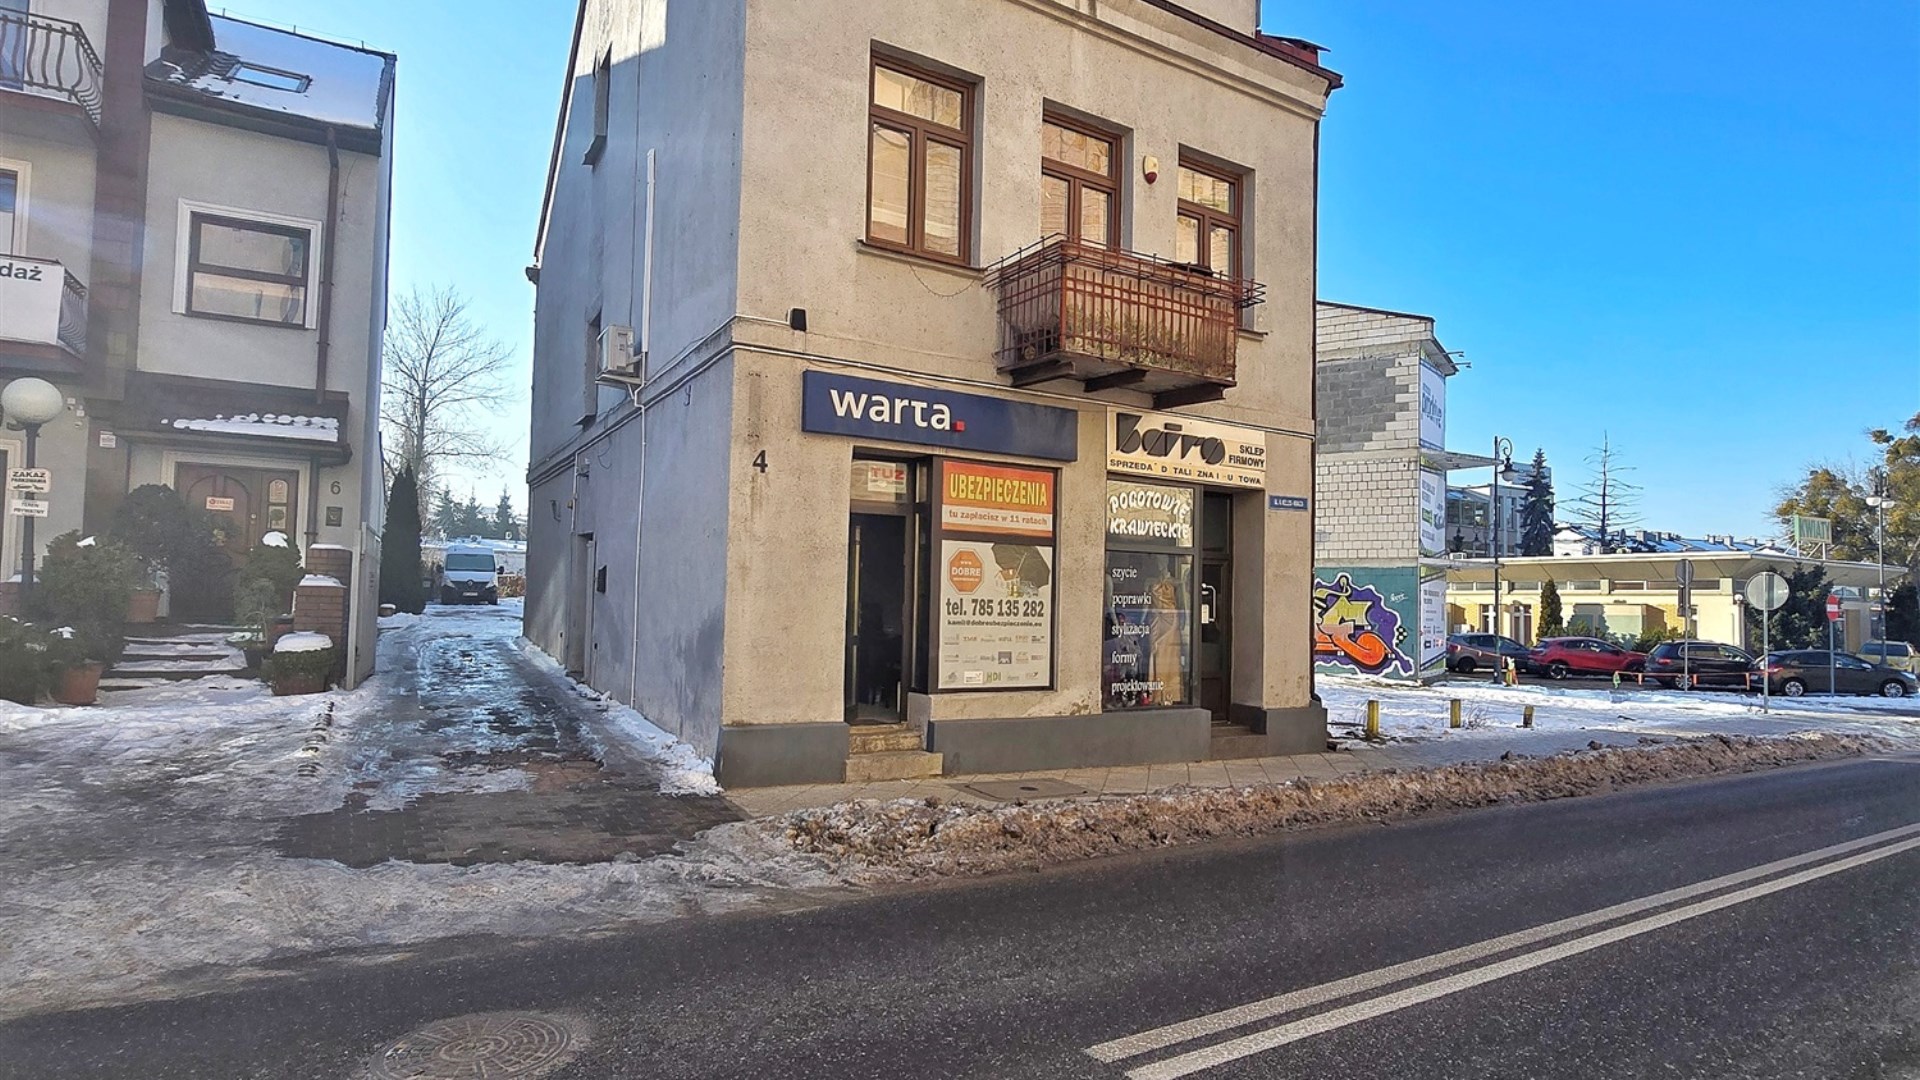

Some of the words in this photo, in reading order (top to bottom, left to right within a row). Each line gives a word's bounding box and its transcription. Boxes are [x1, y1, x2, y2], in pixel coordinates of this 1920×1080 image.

[0, 262, 42, 281] daż
[1239, 444, 1265, 456] SKLEP
[752, 449, 769, 473] 4
[1228, 454, 1265, 468] FIRMOWY
[870, 466, 905, 481] TUZ
[330, 480, 341, 495] 6
[949, 473, 1047, 506] UBEZPIECZENIA
[1109, 490, 1191, 522] POGOTOWIE
[949, 509, 958, 518] tu
[960, 511, 999, 521] zapłacisz
[1010, 515, 1020, 523] 11
[1022, 516, 1047, 526] ratach
[1109, 517, 1190, 539] KRAWIECKIE
[951, 566, 981, 577] DOBRE
[1111, 565, 1138, 581] szycie
[946, 598, 967, 616] tel.
[971, 598, 994, 617] 785
[997, 599, 1019, 617] 135
[1022, 600, 1044, 618] 282
[1111, 592, 1152, 608] poprawki
[1111, 622, 1150, 638] stylizacja
[1111, 650, 1138, 666] formy
[1111, 678, 1164, 695] projektowanie
